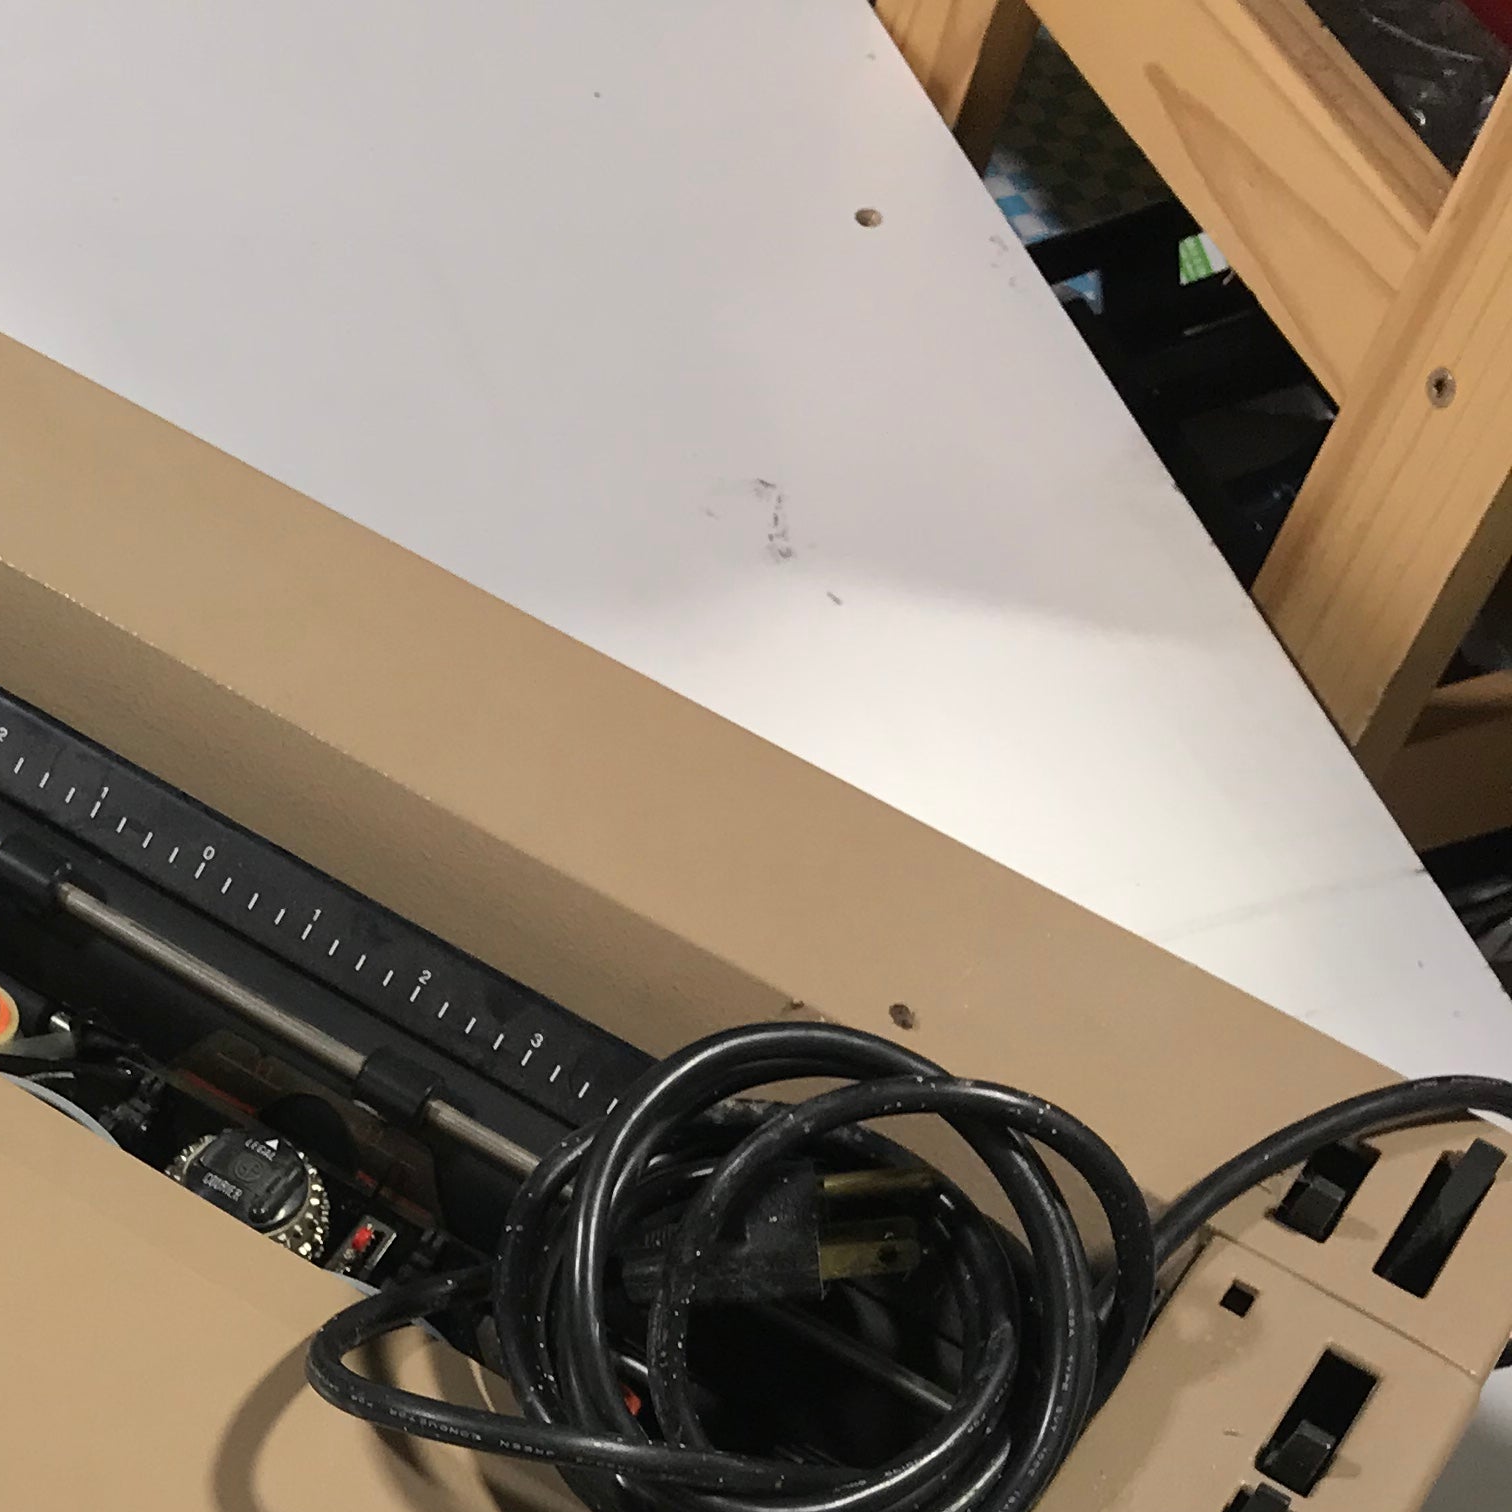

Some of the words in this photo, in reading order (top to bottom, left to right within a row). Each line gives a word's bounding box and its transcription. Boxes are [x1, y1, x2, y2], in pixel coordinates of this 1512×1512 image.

[100, 786, 109, 799] 1
[203, 846, 215, 860] 0
[313, 909, 321, 921] 1
[419, 970, 431, 984] 2
[531, 1033, 543, 1047] 3
